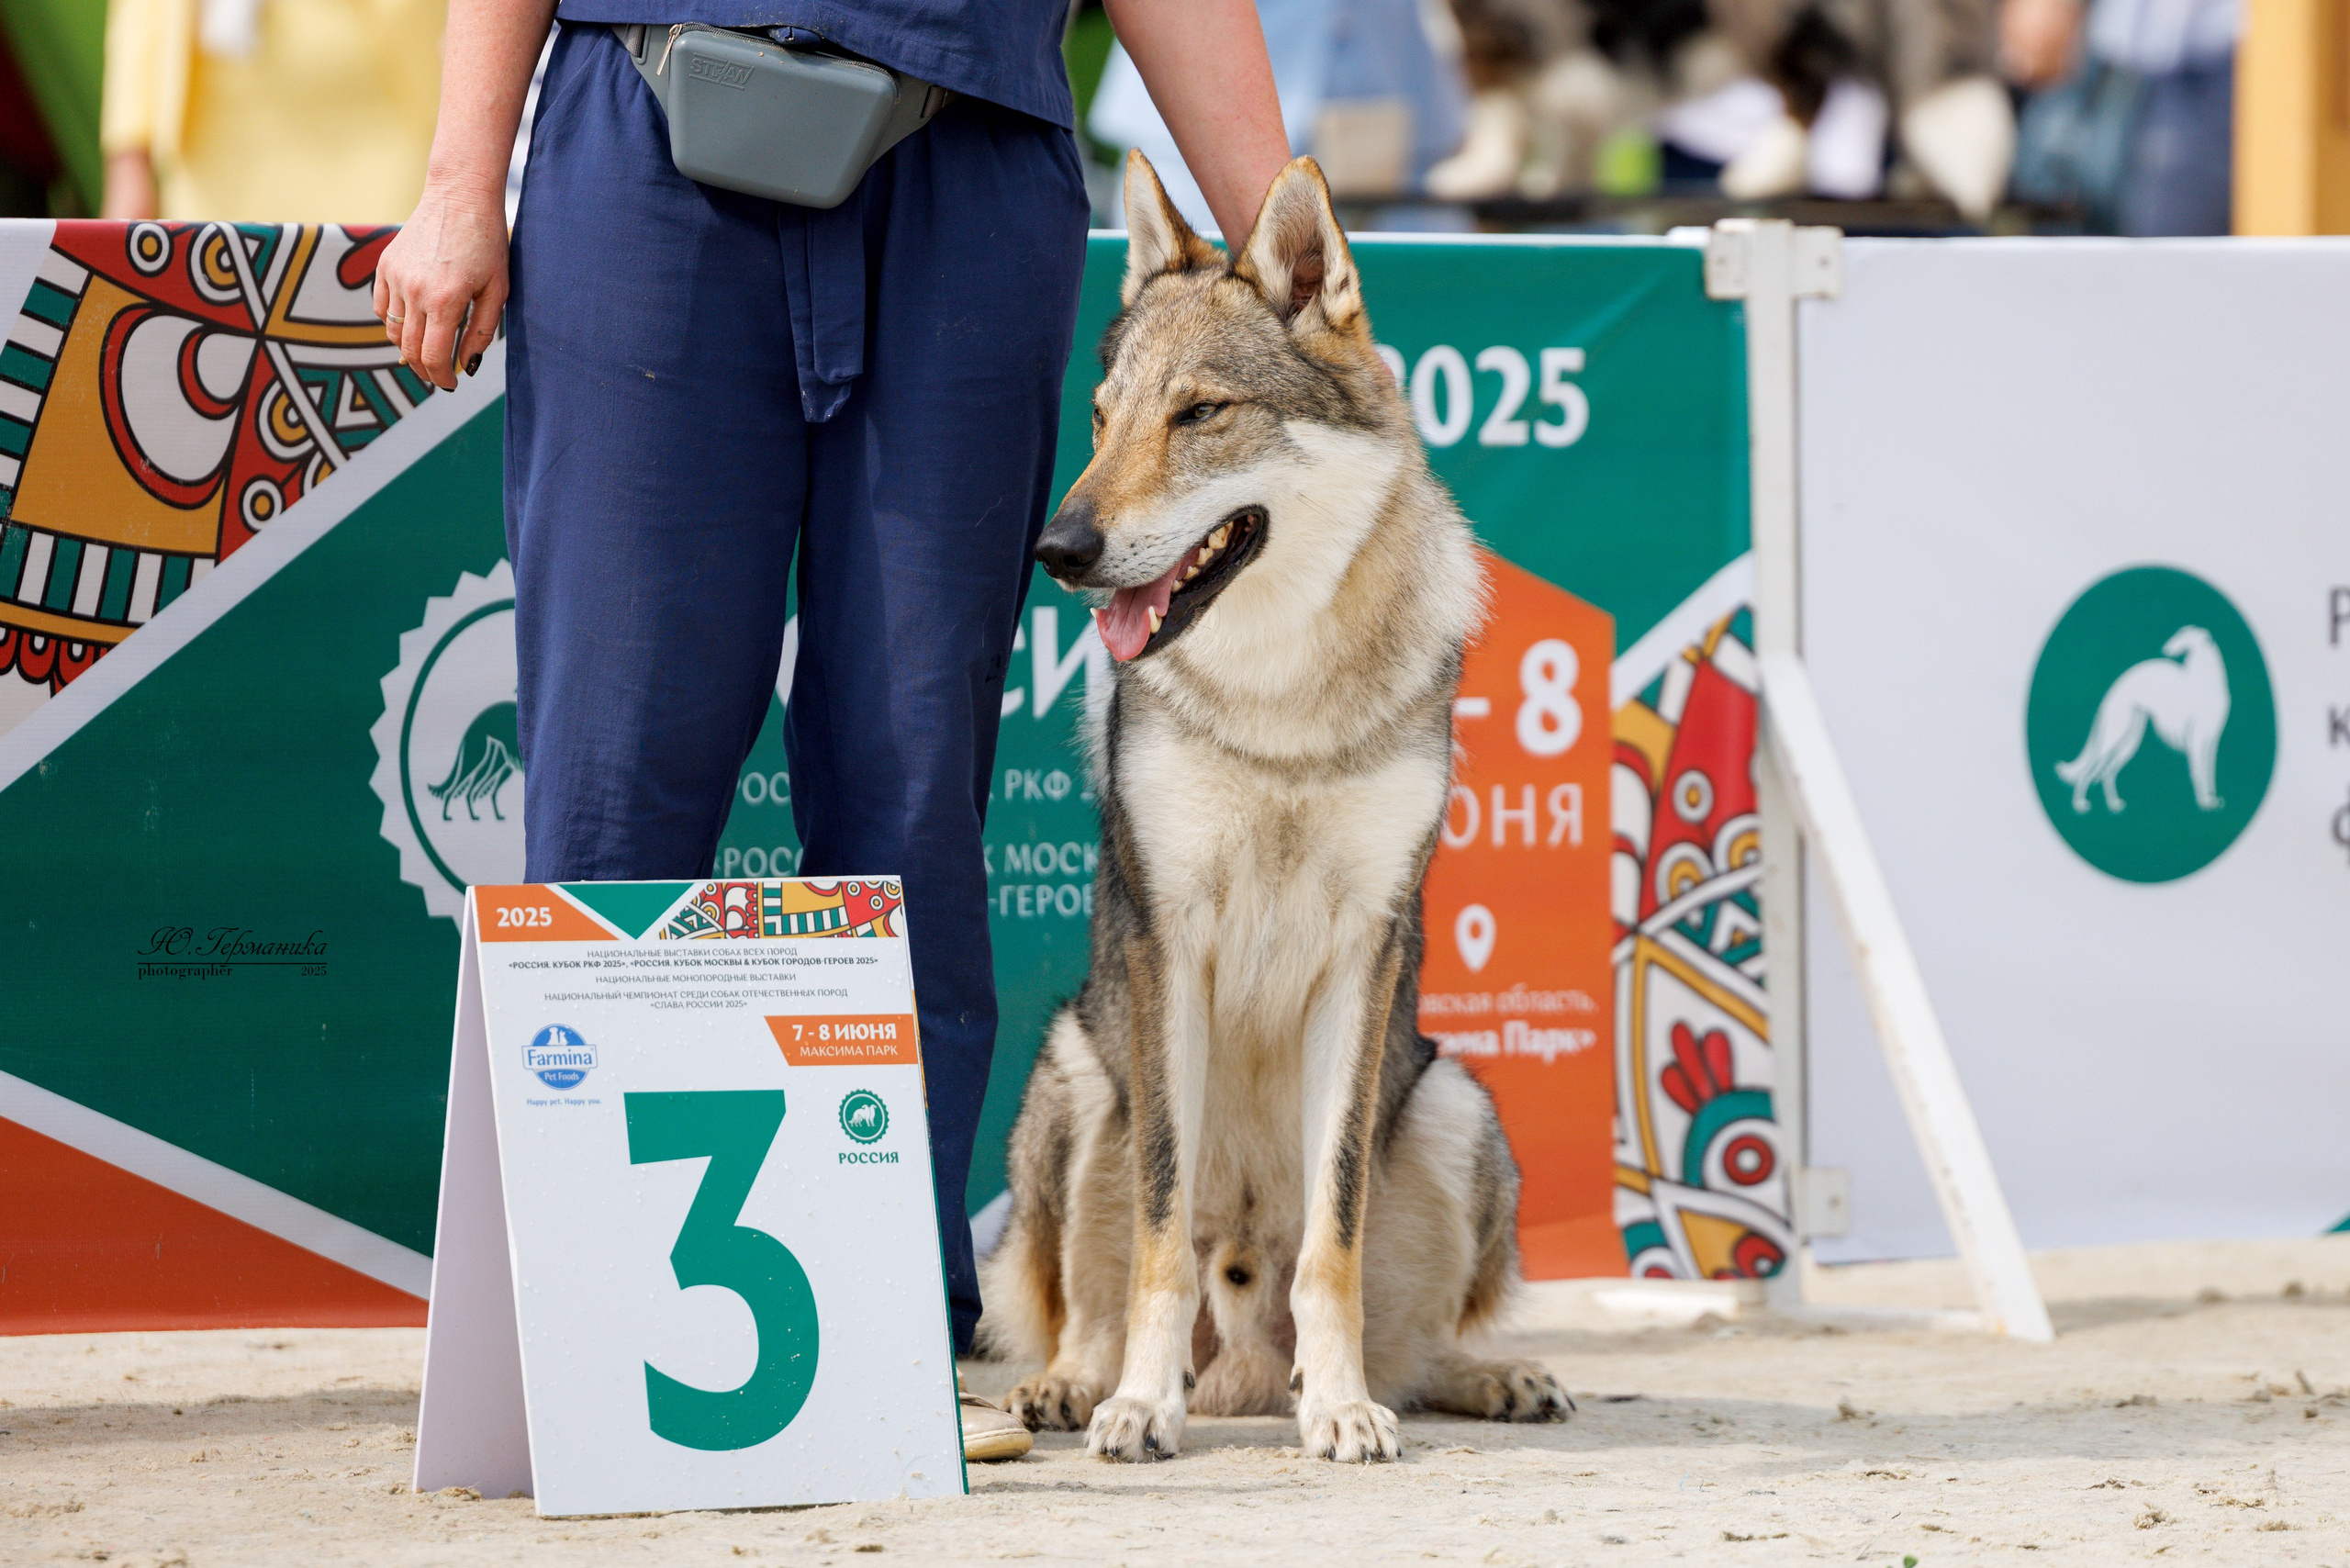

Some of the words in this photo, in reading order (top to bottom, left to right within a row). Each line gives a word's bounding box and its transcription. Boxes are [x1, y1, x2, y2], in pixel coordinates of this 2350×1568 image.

[1516, 638, 1583, 757] 8
[1004, 768, 1072, 801] РКФ
[496, 906, 553, 928] 2025
[588, 949, 662, 959] НАЦИОНАЛЬНЫЕ
[664, 948, 711, 958] ВЫСТАВКИ
[743, 947, 766, 957] ВСЕХ
[767, 947, 798, 957] ПОРОД
[509, 961, 552, 969] «РОССИЯ.
[583, 960, 601, 969] РКФ
[630, 959, 672, 968] «РОССИЯ.
[674, 958, 702, 967] КУБОК
[704, 958, 743, 967] МОСКВЫ
[752, 958, 780, 966] КУБОК
[781, 957, 855, 966] ГОРОДОВ-ГЕРОЕВ
[856, 957, 878, 965] 2025»
[596, 975, 670, 984] НАЦИОНАЛЬНЫЕ
[672, 973, 747, 983] МОНОПОРОДНЫЕ
[749, 973, 797, 981] ВЫСТАВКИ
[544, 991, 621, 1001] НАЦИОНАЛЬНЫЙ
[622, 991, 678, 1000] ЧЕМПИОНАТ
[679, 991, 709, 999] СРЕДИ
[711, 990, 741, 998] СОБАК
[742, 989, 816, 998] ОТЕЧЕСТВЕННЫХ
[817, 989, 848, 998] ПОРОД
[650, 1001, 685, 1009] «СЛАВА
[686, 1000, 723, 1009] РОССИИ
[725, 1000, 747, 1008] 2025»
[791, 1024, 803, 1041] 7
[818, 1024, 831, 1041] 8
[834, 1023, 897, 1040] ИЮНЯ
[527, 1048, 593, 1066] Farmina
[800, 1046, 864, 1057] МАКСИМА
[867, 1045, 899, 1056] ПАРК
[544, 1071, 557, 1081] Pet
[558, 1071, 580, 1081] Foods
[526, 1098, 548, 1107] Happy
[565, 1097, 586, 1106] Happy
[838, 1151, 900, 1164] РОССИЯ
[623, 1089, 820, 1451] 3
